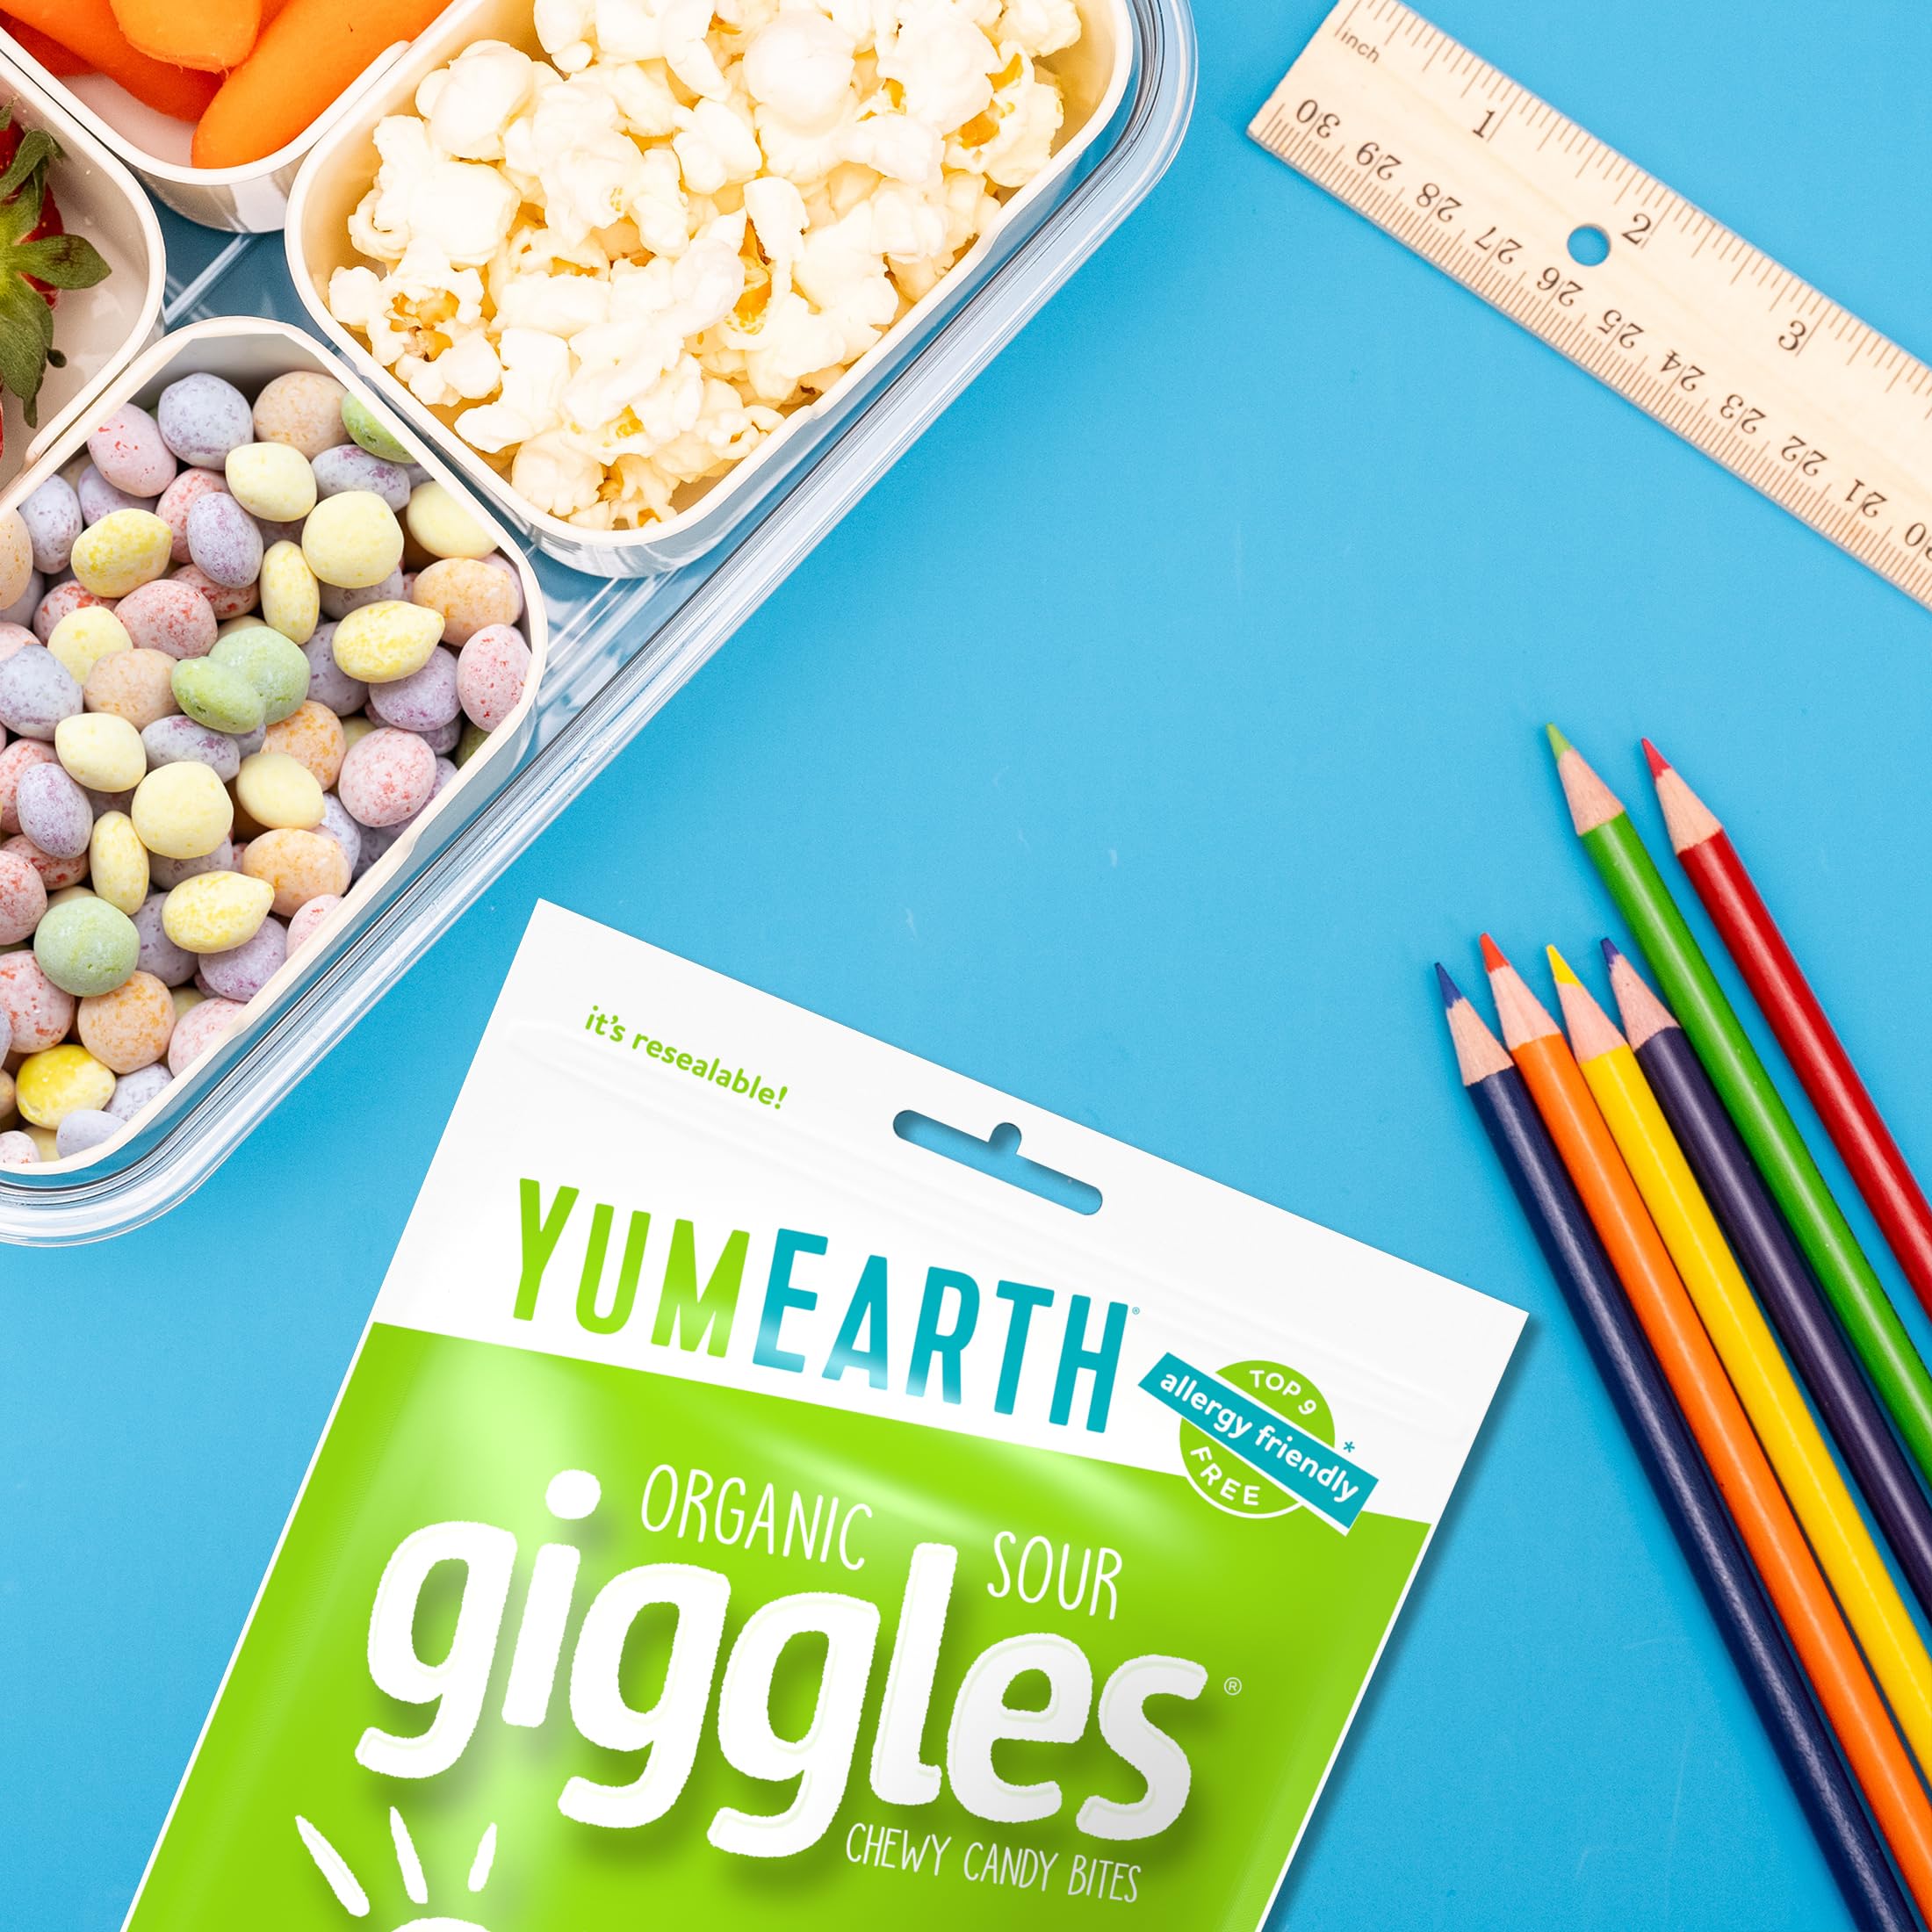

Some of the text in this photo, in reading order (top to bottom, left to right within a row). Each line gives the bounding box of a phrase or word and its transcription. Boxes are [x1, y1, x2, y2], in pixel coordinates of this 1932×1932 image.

[1340, 27, 1381, 64] inch
[1472, 110, 1807, 351] 1 2 3
[1295, 98, 1932, 561] 0 21 22 23 24 25 26 27 28 29 30
[632, 1030, 789, 1110] resealable!
[1159, 1373, 1359, 1503] allergy friendly
[1249, 1369, 1317, 1416] TOP 9
[1189, 1445, 1261, 1506] FREE
[640, 1464, 1124, 1620] ORGANIC SOUR
[354, 1468, 1208, 1858] giggles
[846, 1822, 1142, 1903] CHEWY CANDY BITES
